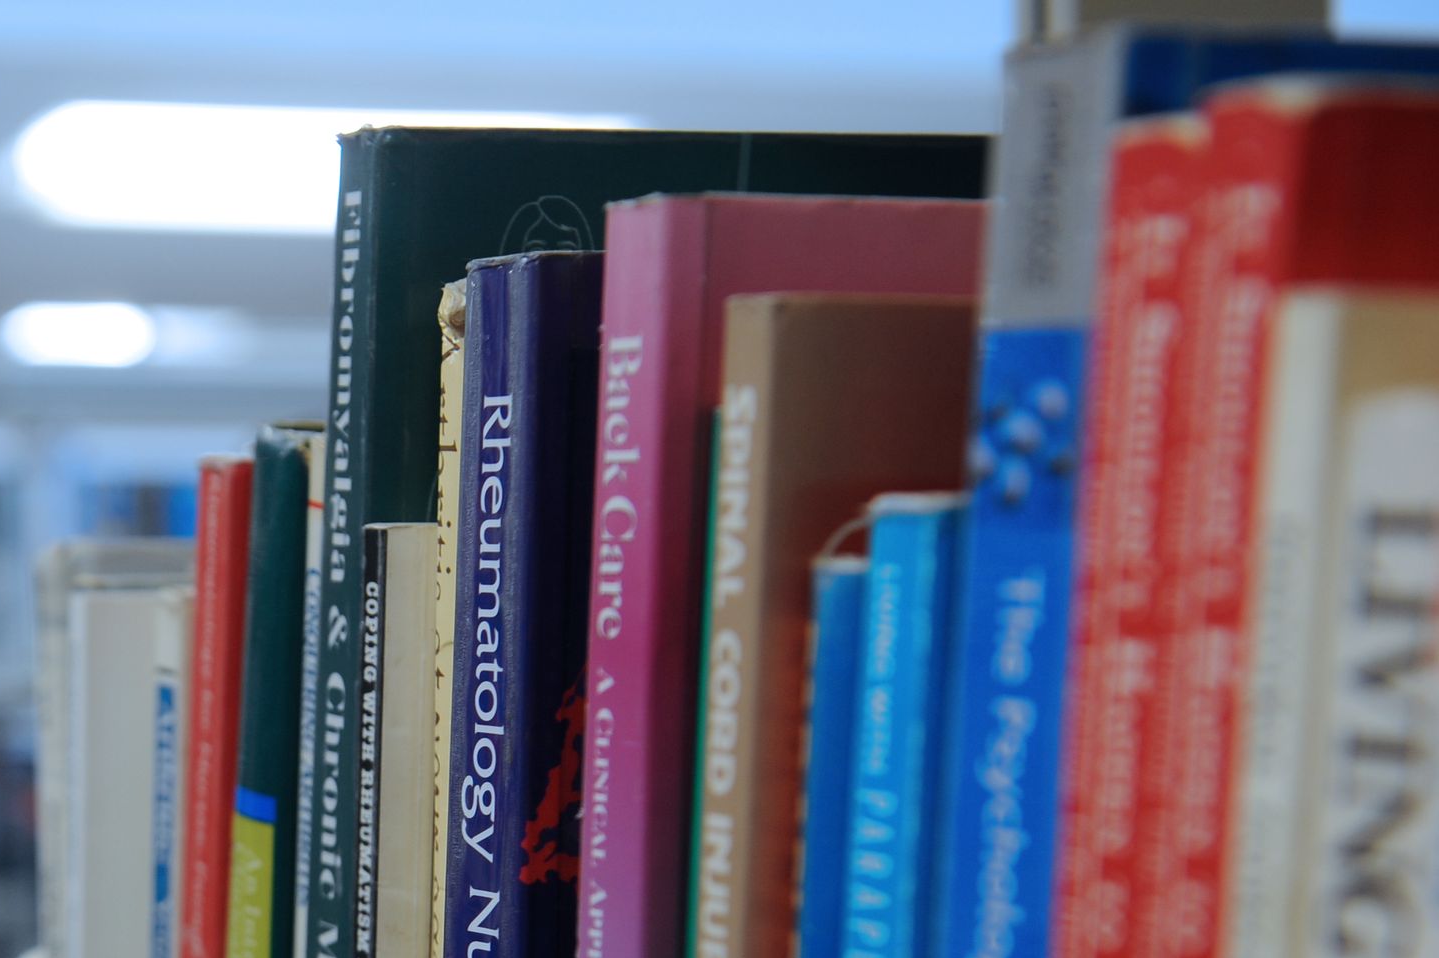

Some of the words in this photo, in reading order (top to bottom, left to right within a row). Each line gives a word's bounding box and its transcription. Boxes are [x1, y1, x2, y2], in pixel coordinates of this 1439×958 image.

[329, 190, 362, 583] Fibromyalgia
[600, 335, 643, 488] Back
[595, 494, 638, 640] Care
[713, 383, 759, 607] SPINAL
[328, 603, 349, 649] &
[361, 580, 379, 683] COPING
[460, 394, 513, 863] Rheumatology
[595, 666, 615, 696] A
[991, 568, 1048, 685] The
[319, 671, 346, 901] Chronic
[360, 689, 377, 762] WITH
[706, 630, 743, 797] CORD
[356, 768, 374, 953] RHEUMATISM
